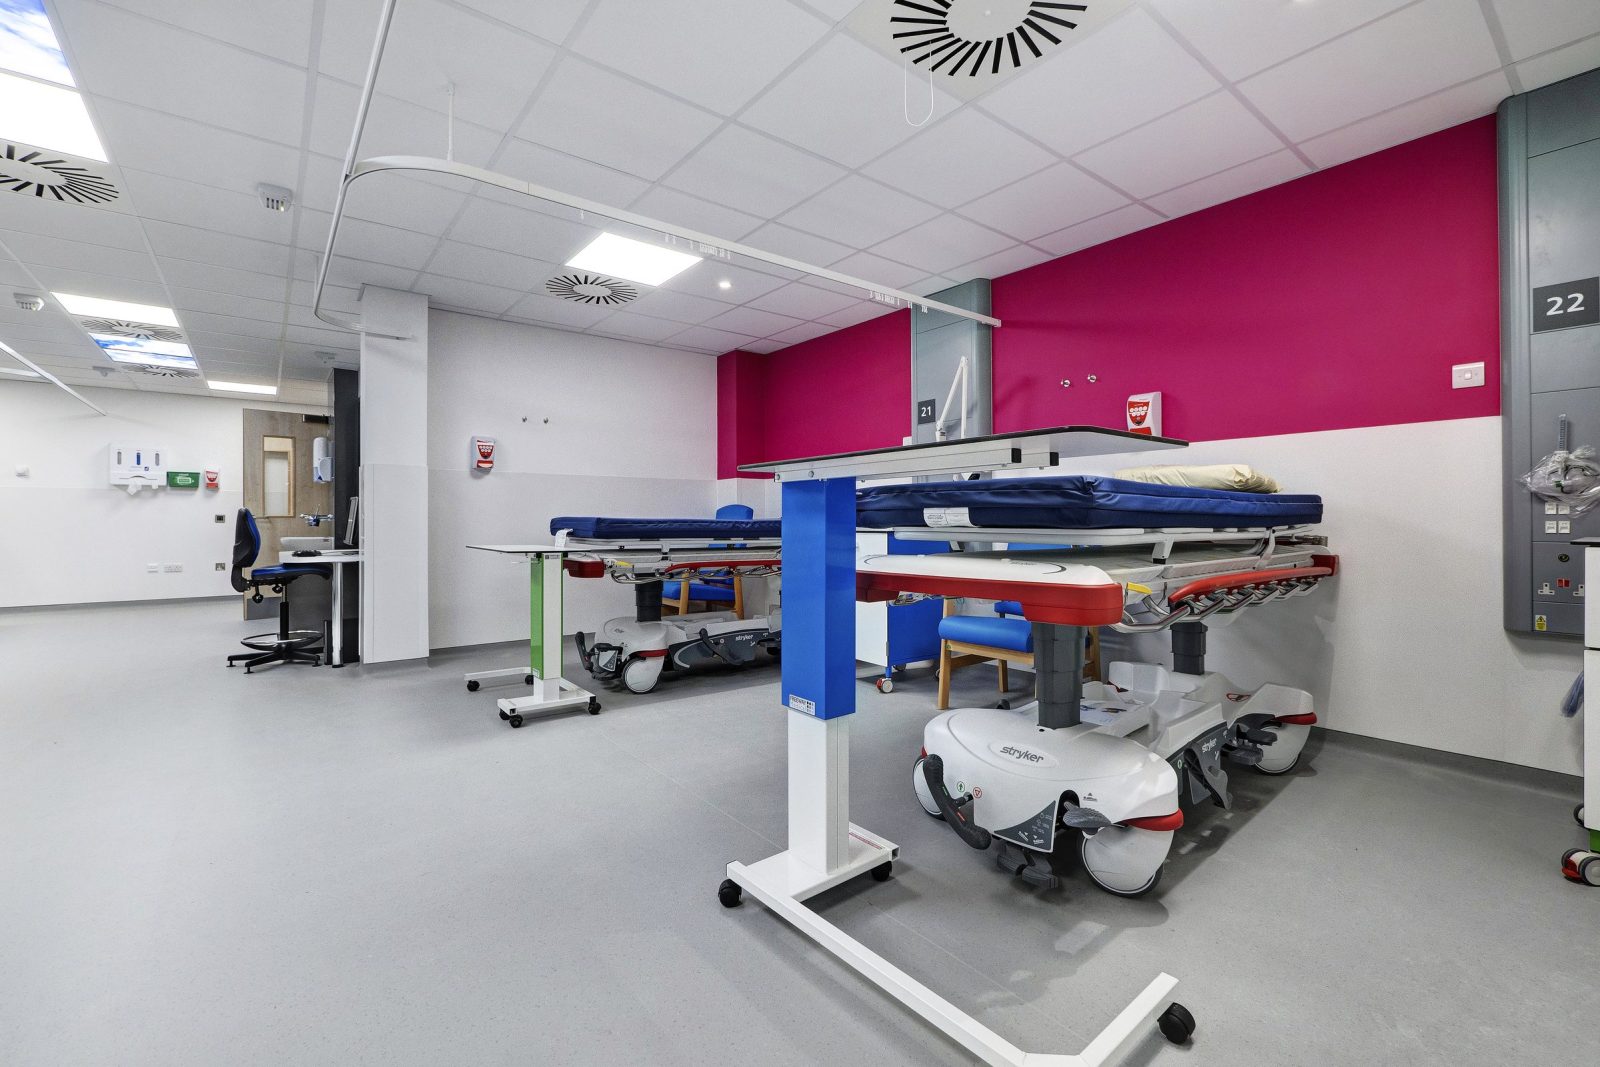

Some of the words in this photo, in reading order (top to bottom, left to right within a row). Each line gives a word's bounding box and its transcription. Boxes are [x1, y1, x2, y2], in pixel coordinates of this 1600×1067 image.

[1546, 293, 1585, 316] 22
[921, 406, 931, 417] 21
[1000, 746, 1044, 763] stryker
